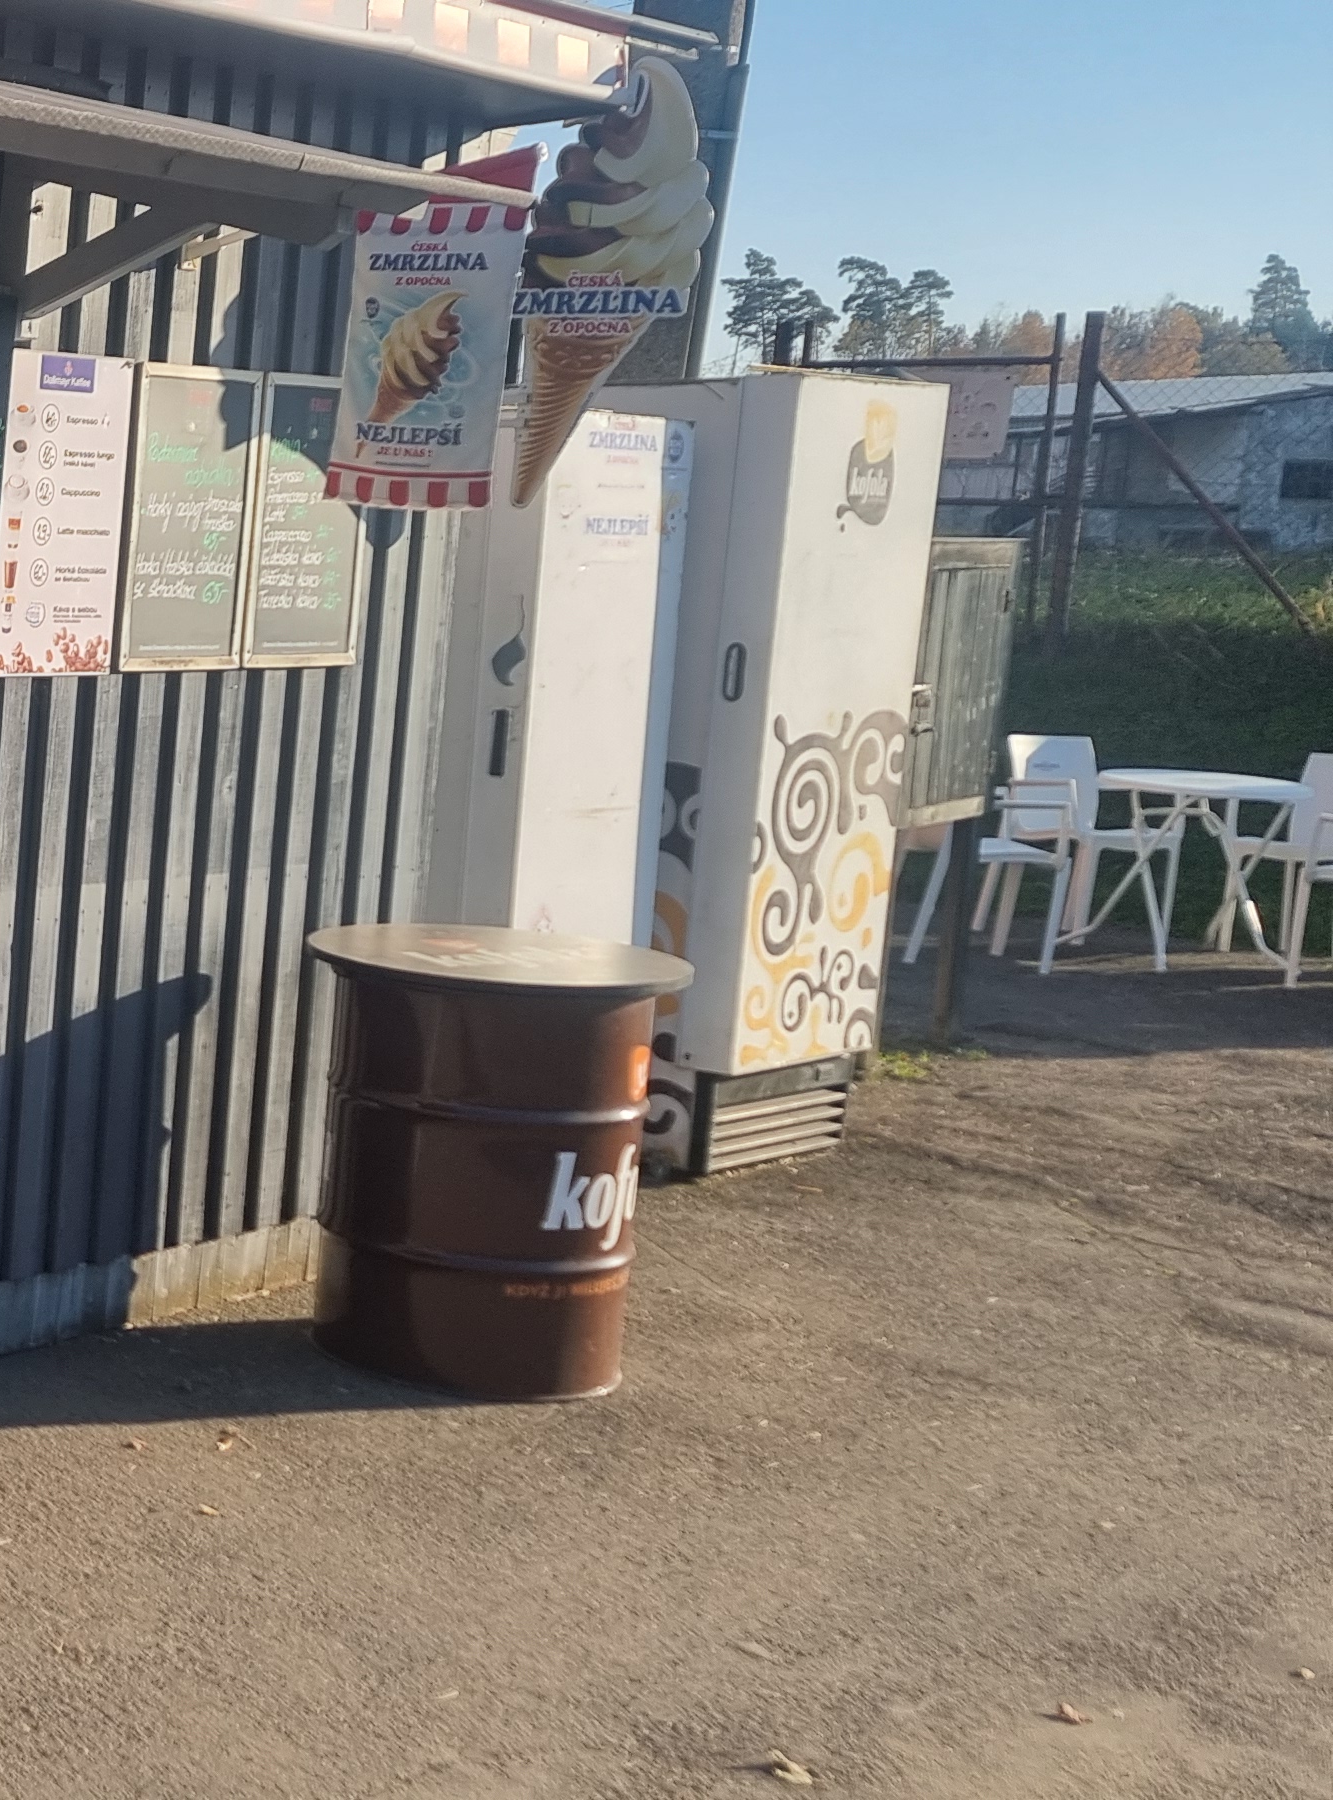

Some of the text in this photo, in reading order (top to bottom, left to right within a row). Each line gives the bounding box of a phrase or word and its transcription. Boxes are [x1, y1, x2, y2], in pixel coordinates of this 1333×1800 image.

[412, 241, 448, 251] ČESKÁ
[370, 252, 488, 271] ZMRZLINA
[396, 274, 451, 285] Z OPOČNA
[568, 271, 622, 287] ČESKÁ
[512, 289, 682, 314] ZMRZLINA
[550, 319, 630, 334] Z OPOČNA
[356, 422, 462, 446] NEJLEPŠÍ
[589, 432, 657, 452] ZMRZLINA
[849, 467, 888, 504] kofola
[585, 514, 649, 535] NEJLEPŠÍ
